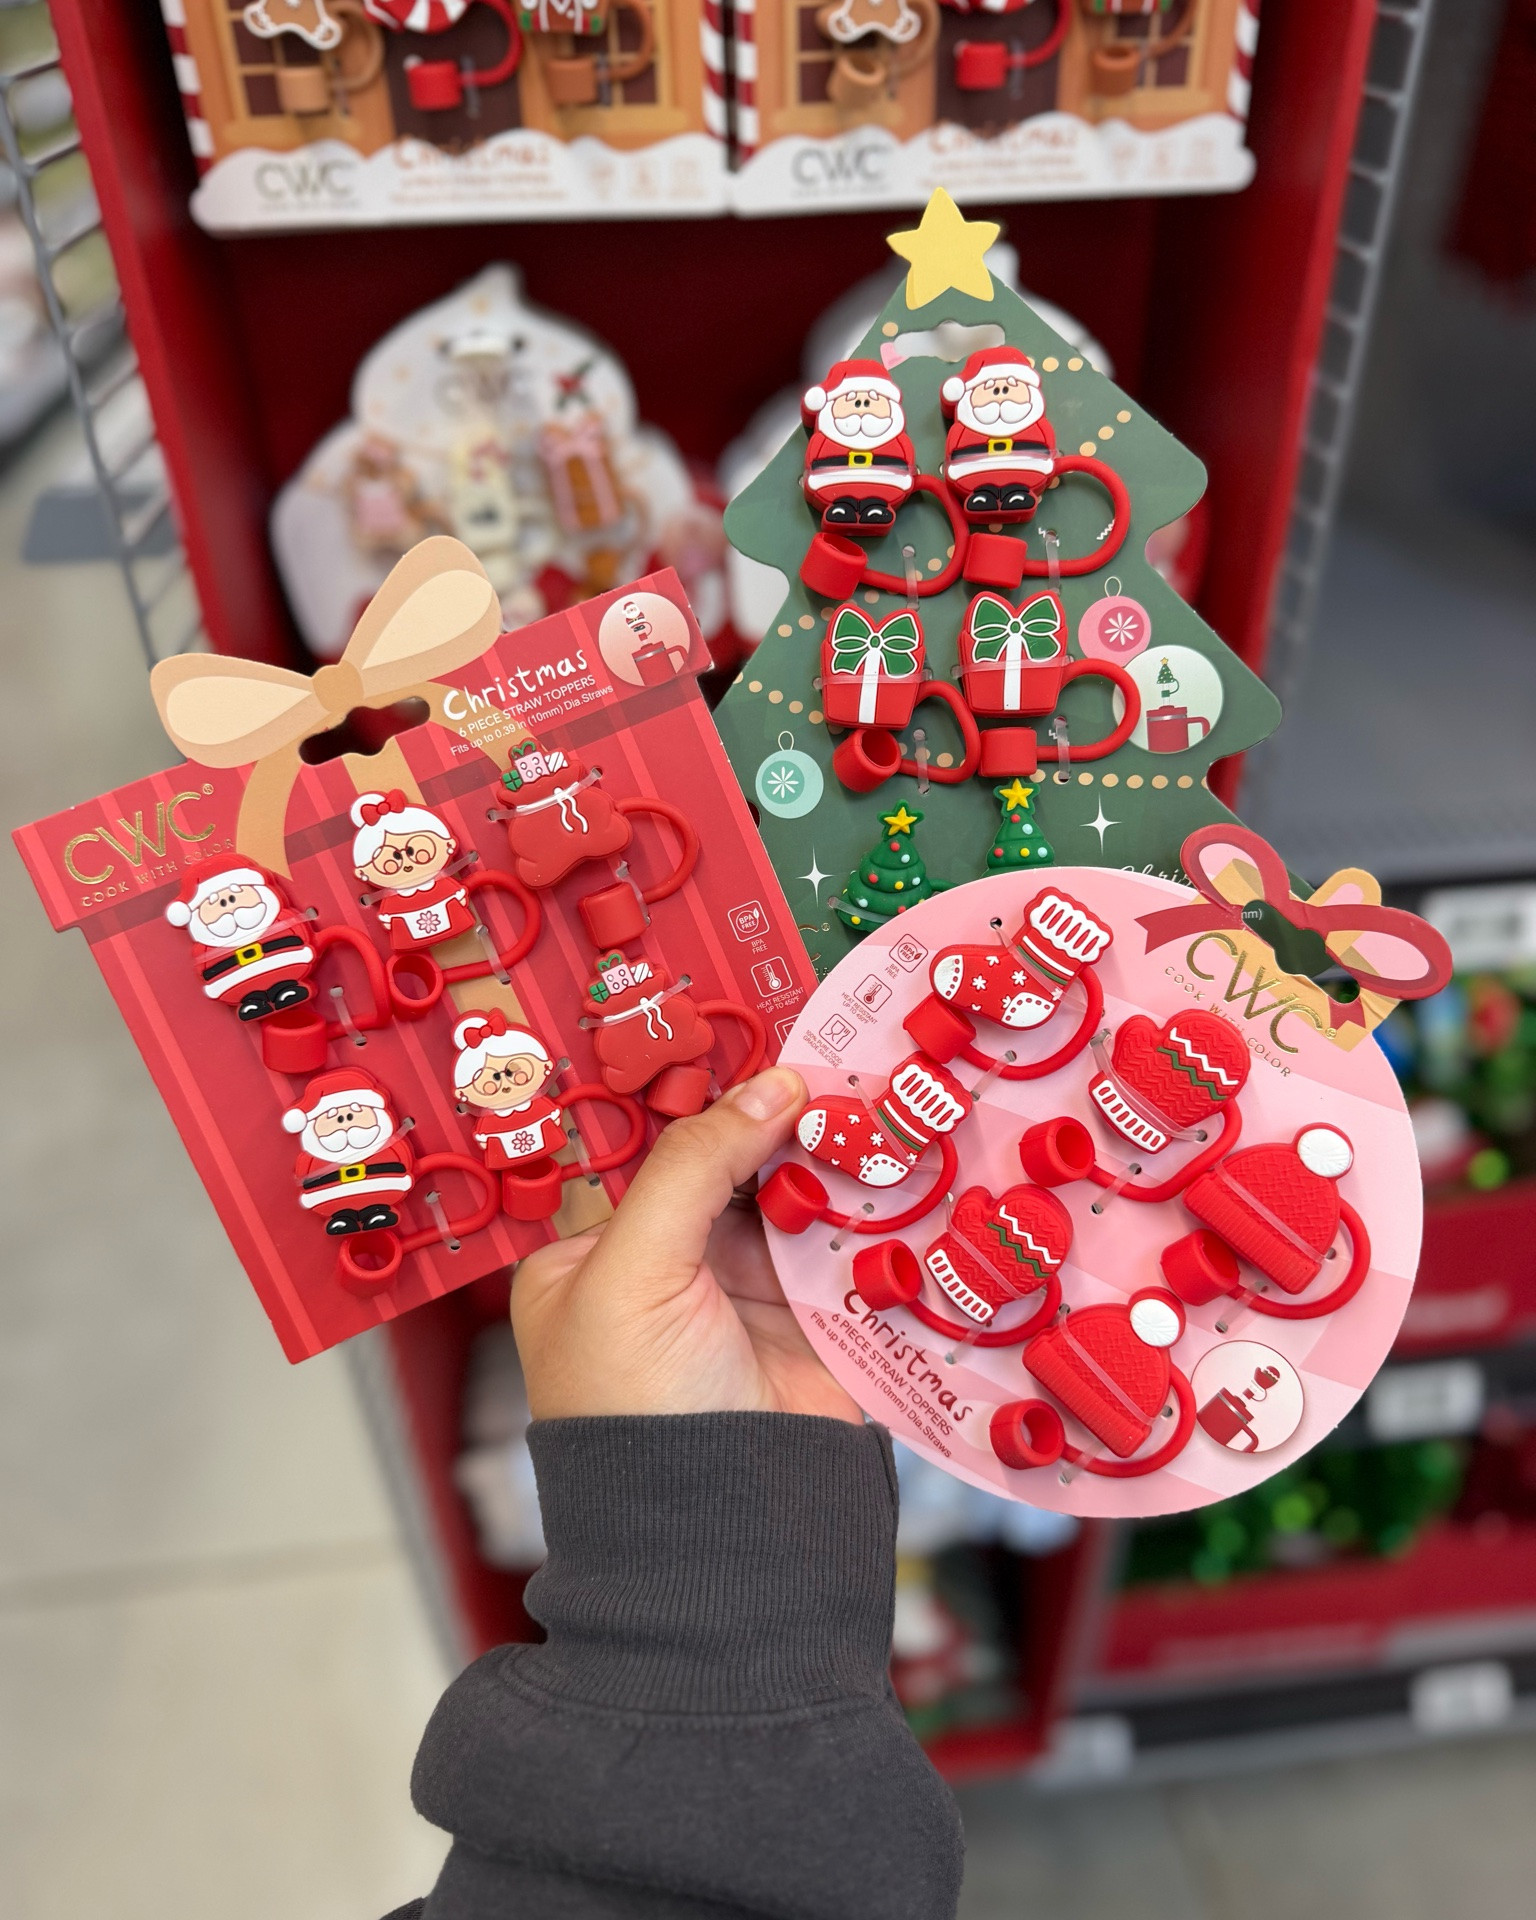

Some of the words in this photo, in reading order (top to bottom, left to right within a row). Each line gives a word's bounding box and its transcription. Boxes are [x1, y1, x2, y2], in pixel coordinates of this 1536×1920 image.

[791, 143, 893, 187] CWC
[255, 159, 356, 200] CWC
[443, 650, 587, 720] Christmas
[459, 728, 467, 738] 6
[469, 712, 502, 733] PIECE
[503, 697, 543, 720] STRAW
[543, 675, 596, 702] TOPPERS
[451, 743, 469, 756] Fits
[471, 737, 484, 750] up
[484, 732, 494, 743] to
[495, 724, 516, 740] 0.39
[518, 719, 527, 729] in
[527, 704, 564, 729] (10mm)
[82, 881, 130, 907] COOK
[136, 861, 178, 884] WITH
[184, 838, 234, 865] COLOR
[739, 914, 754, 925] BPA
[741, 920, 756, 930] FREE
[751, 939, 765, 948] BPA
[752, 944, 768, 955] FREE
[900, 949, 912, 960] FREE
[903, 945, 915, 956] BPA
[885, 967, 898, 979] FREE
[890, 963, 900, 973] BPA
[757, 998, 772, 1010] HEAT
[773, 987, 804, 1003] RESISTANT
[766, 1005, 775, 1013] UP
[775, 1002, 784, 1010] TO
[841, 992, 854, 1004] HEAT
[853, 1002, 878, 1025] RESISTANT
[842, 1000, 851, 1008] UP
[849, 1007, 857, 1015] TO
[1165, 966, 1206, 1002] COOK
[1209, 1003, 1245, 1033] WIT
[1247, 1037, 1291, 1078] COLOR
[803, 1035, 819, 1051] GRADE
[818, 1048, 840, 1069] SILICONE
[805, 1030, 817, 1041] 100%
[817, 1039, 830, 1051] PURE
[810, 1311, 827, 1330] Fits
[826, 1328, 838, 1342] up
[838, 1339, 848, 1350] to
[847, 1349, 868, 1370] 0.39
[866, 1368, 877, 1381] in
[874, 1378, 909, 1413] (10mm)
[844, 1289, 973, 1421] Christmas
[831, 1313, 840, 1323] 6
[839, 1319, 872, 1353] PIECE
[868, 1349, 907, 1388] STRAW
[905, 1385, 954, 1436] TOPPERS
